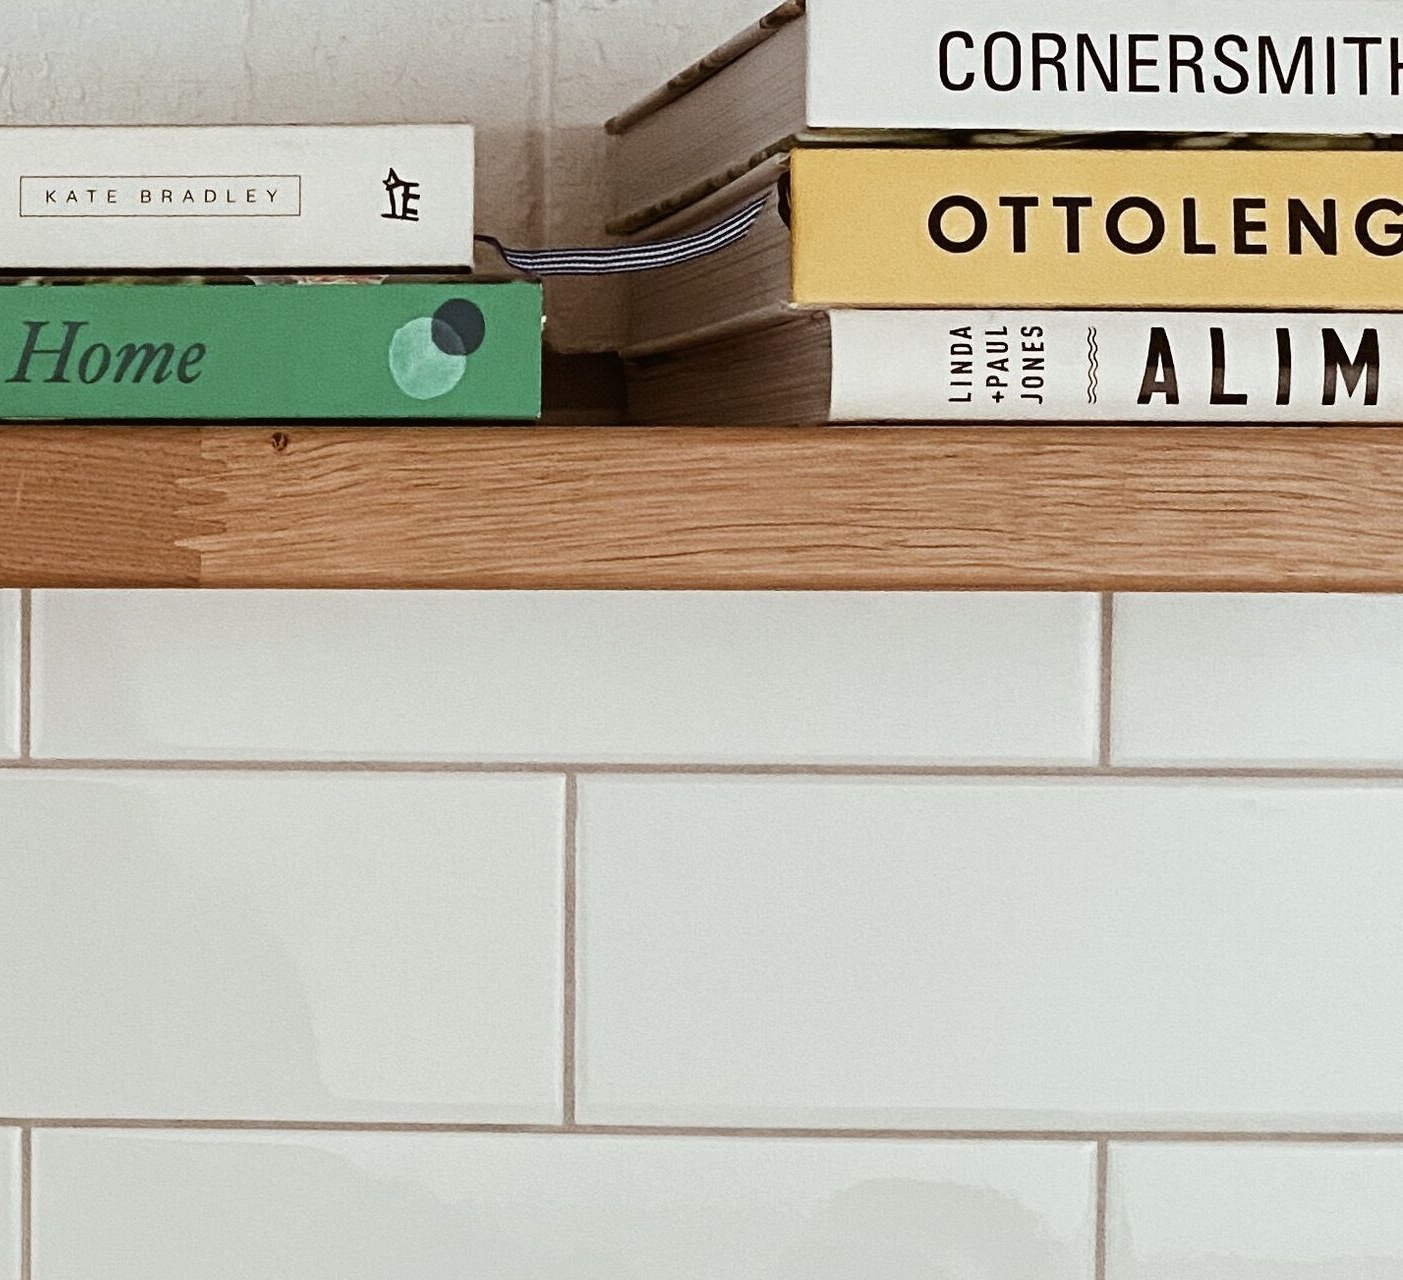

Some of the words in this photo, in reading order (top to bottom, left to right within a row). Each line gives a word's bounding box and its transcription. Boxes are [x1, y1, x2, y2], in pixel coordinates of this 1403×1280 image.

[44, 188, 118, 205] KATE
[139, 188, 279, 205] BRADLEY
[926, 194, 1403, 258] OTTOLENG
[4, 318, 207, 386] Home
[947, 325, 974, 404] LINDA
[983, 324, 1010, 405] +PAUL
[1019, 325, 1046, 406] JONES
[1135, 325, 1381, 407] ALIM
